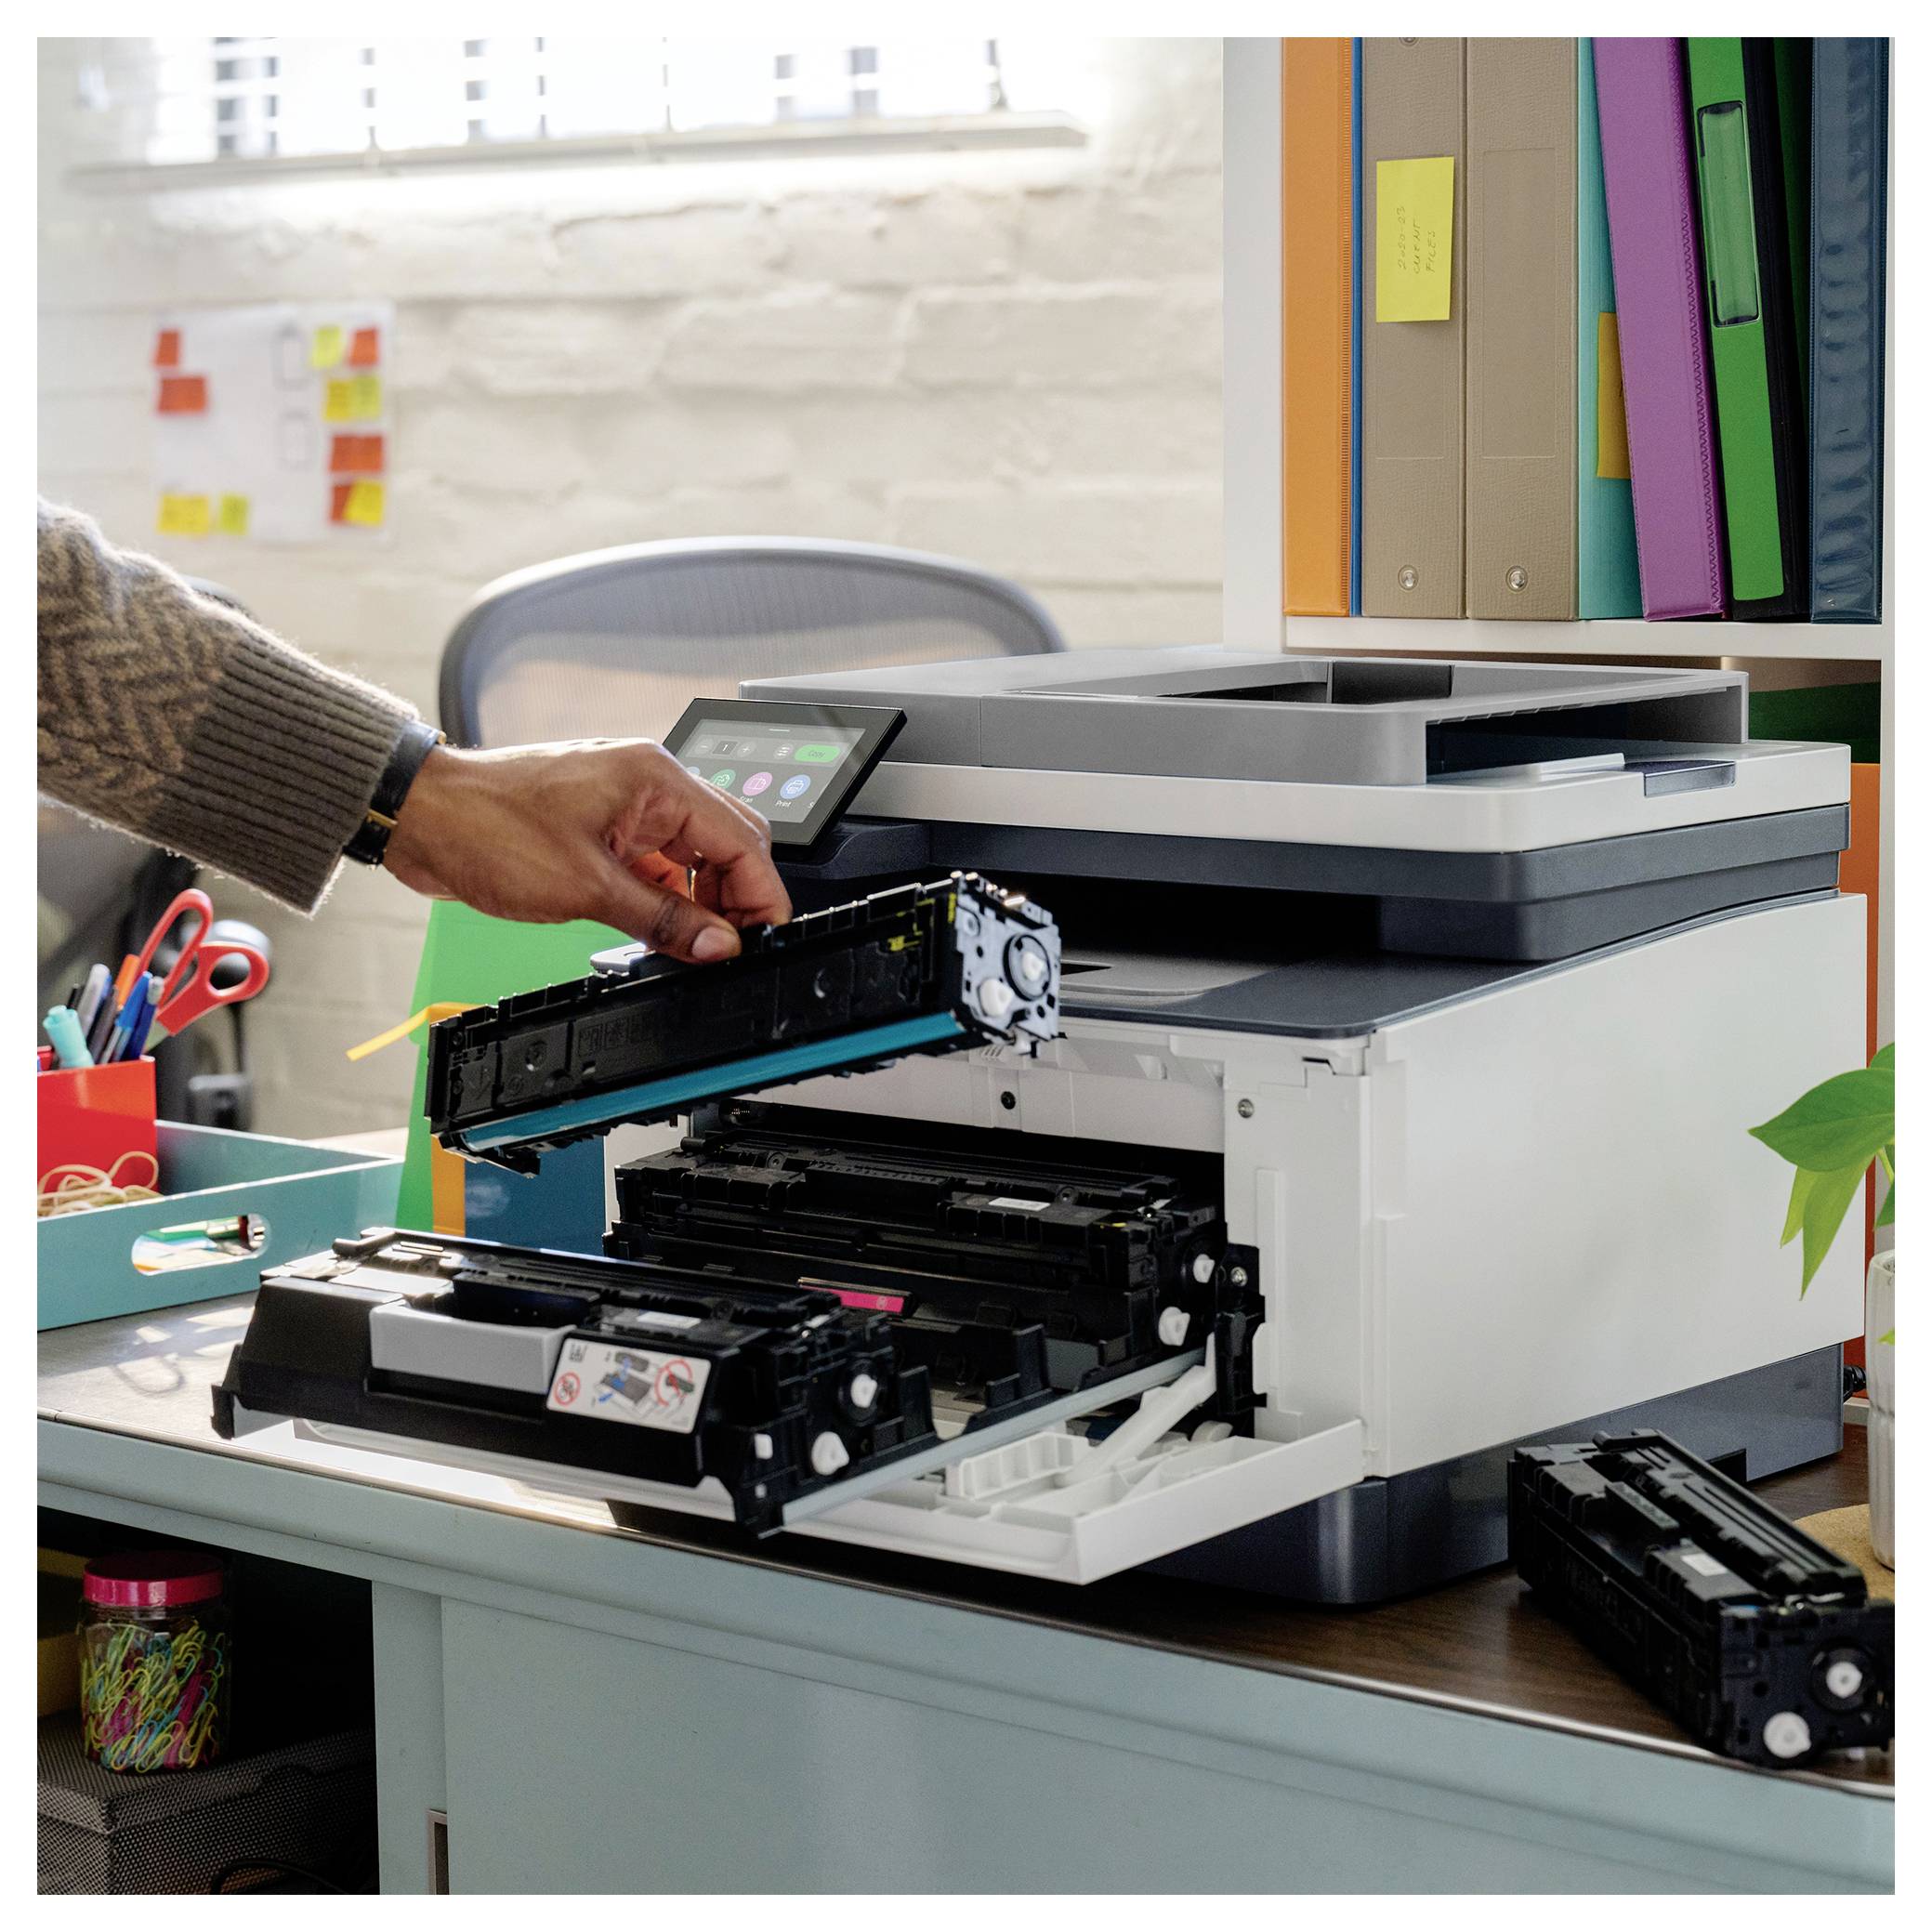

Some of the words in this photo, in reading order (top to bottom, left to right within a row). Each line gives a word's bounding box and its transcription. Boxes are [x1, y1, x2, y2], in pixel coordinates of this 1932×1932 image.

[1397, 205, 1406, 269] 2020-23
[1426, 230, 1436, 272] FILES
[808, 749, 826, 758] Copy
